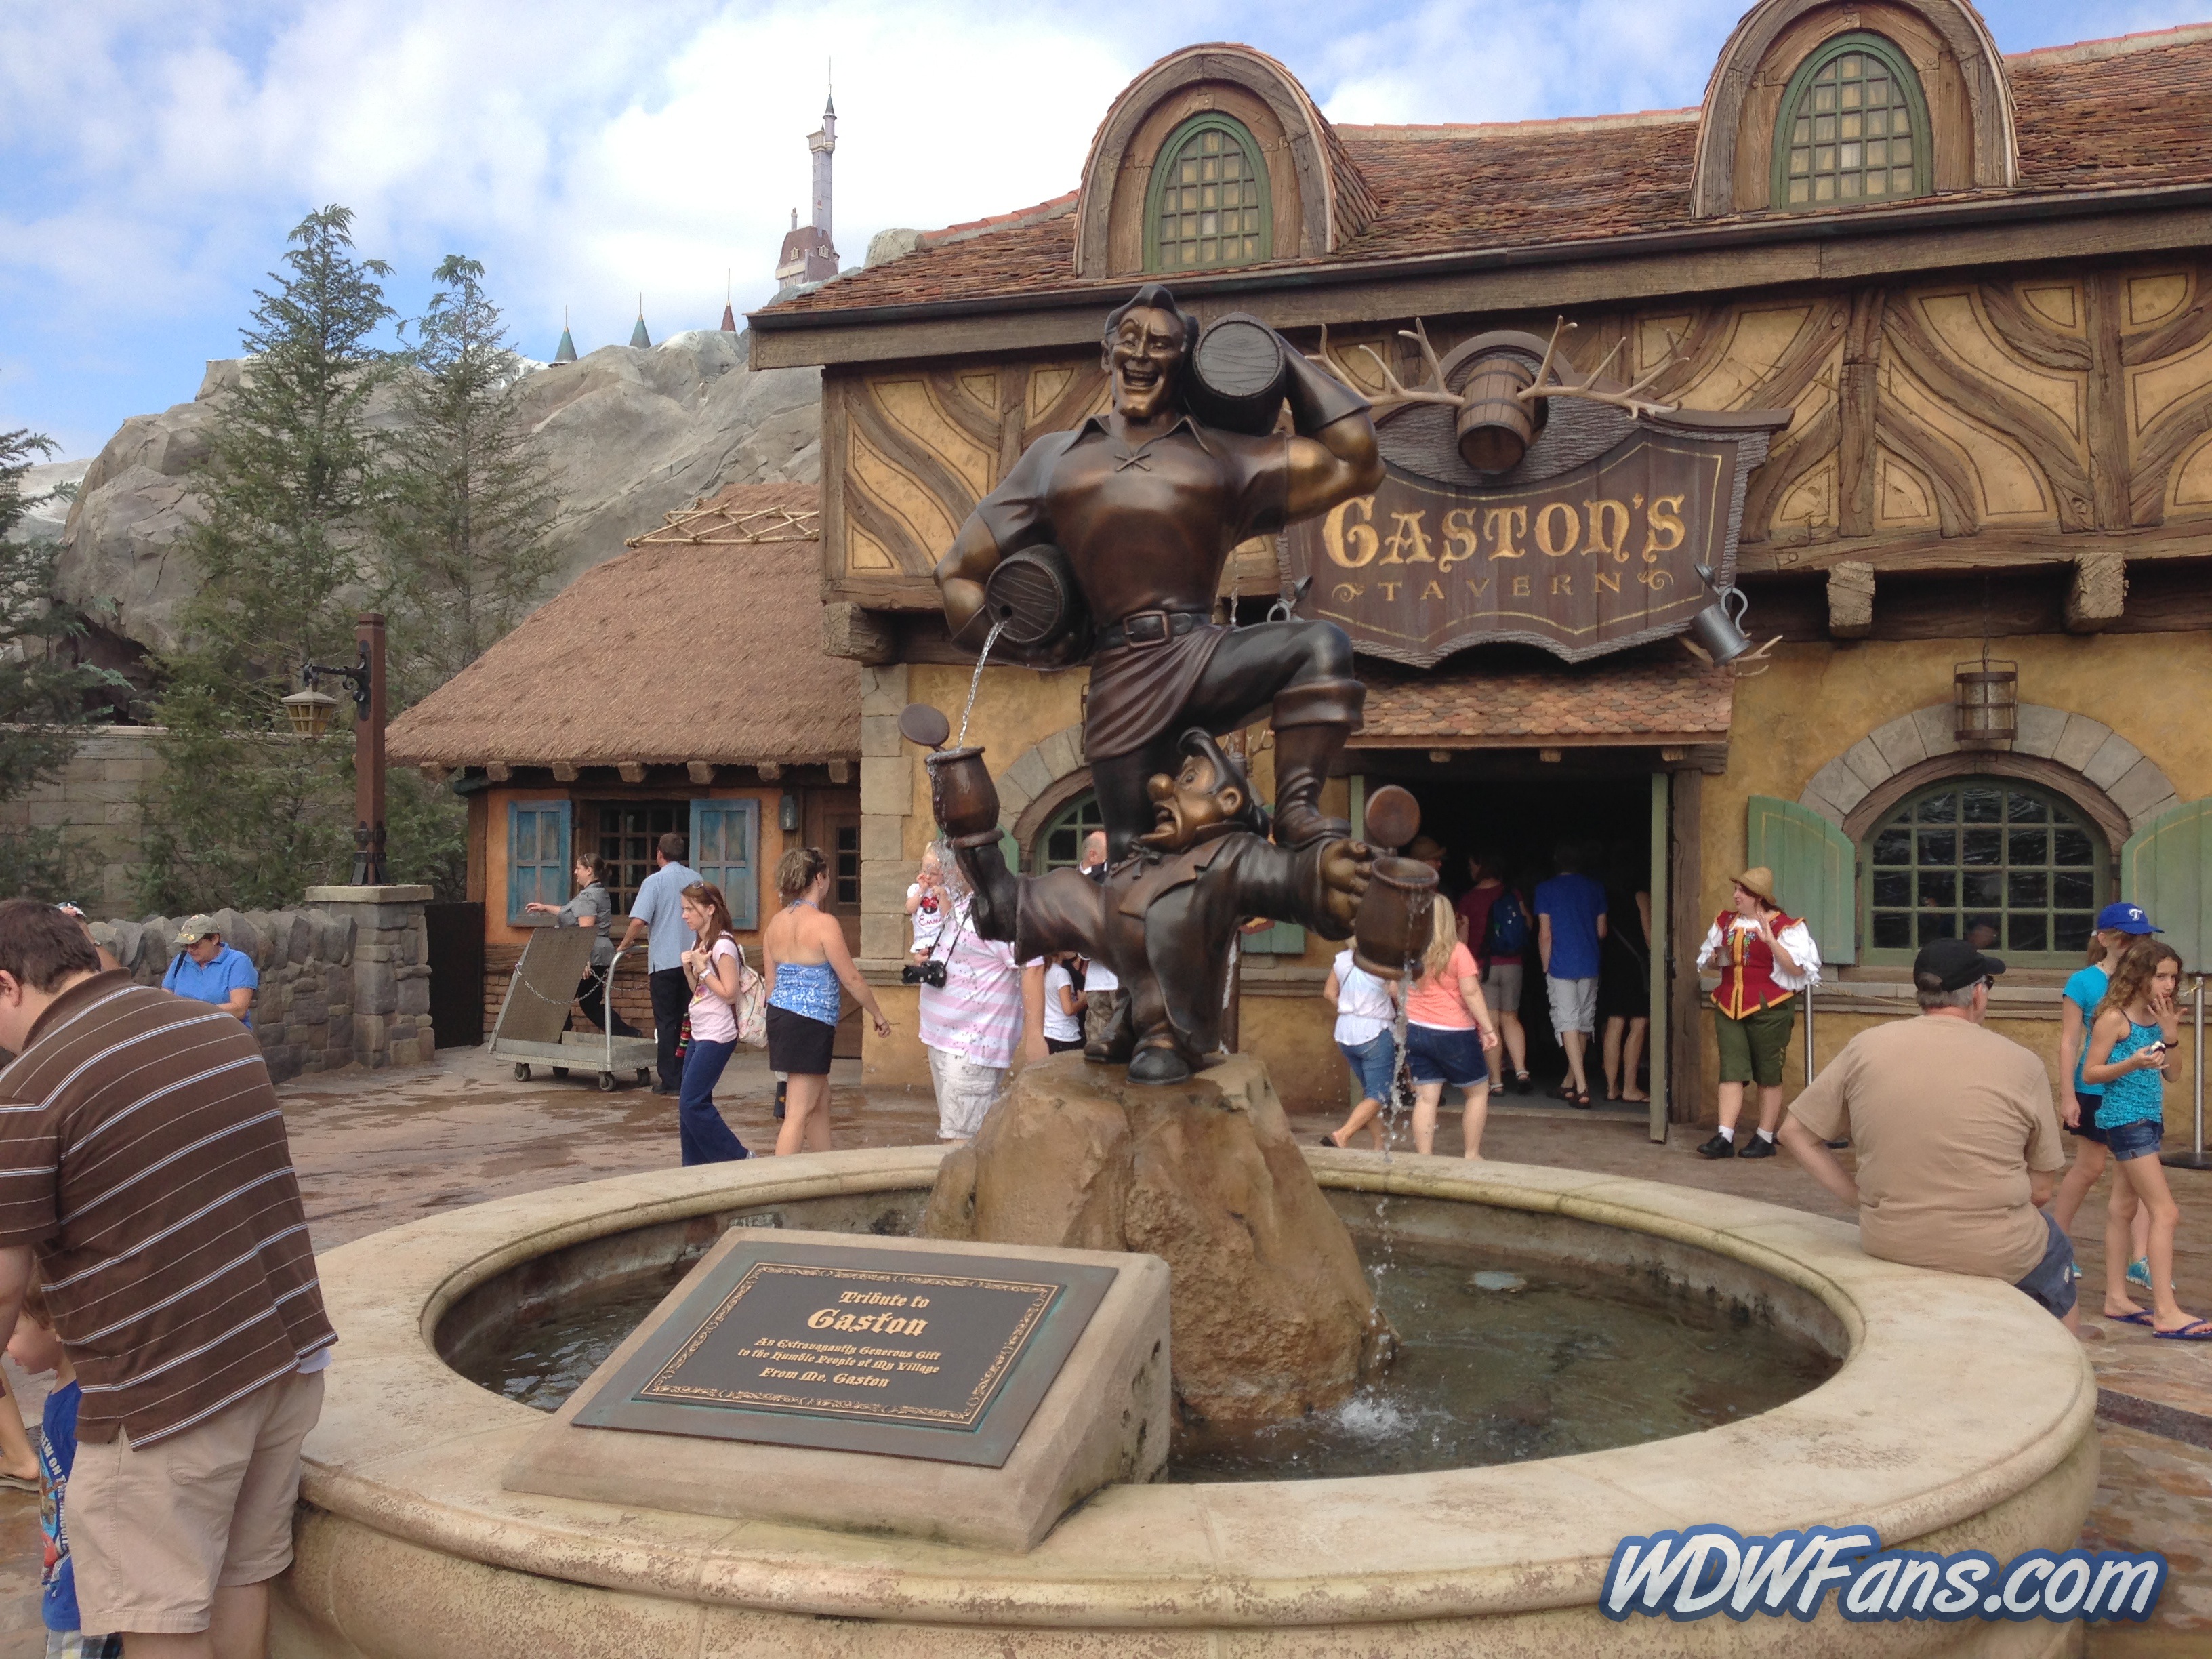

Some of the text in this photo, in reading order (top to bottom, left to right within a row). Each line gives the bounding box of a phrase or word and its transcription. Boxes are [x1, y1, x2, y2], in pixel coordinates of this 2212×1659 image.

[1322, 493, 1686, 573] GASTON'S
[1378, 571, 1622, 602] TAVERN
[838, 1291, 930, 1309] Tribute to
[807, 1308, 928, 1336] Gaston
[754, 1337, 942, 1360] An Extravagantly Generous Gift
[737, 1348, 940, 1374] to the Humble People of My Village
[758, 1367, 799, 1380] From
[833, 1373, 890, 1387] Gaston
[48, 1457, 62, 1475] ON
